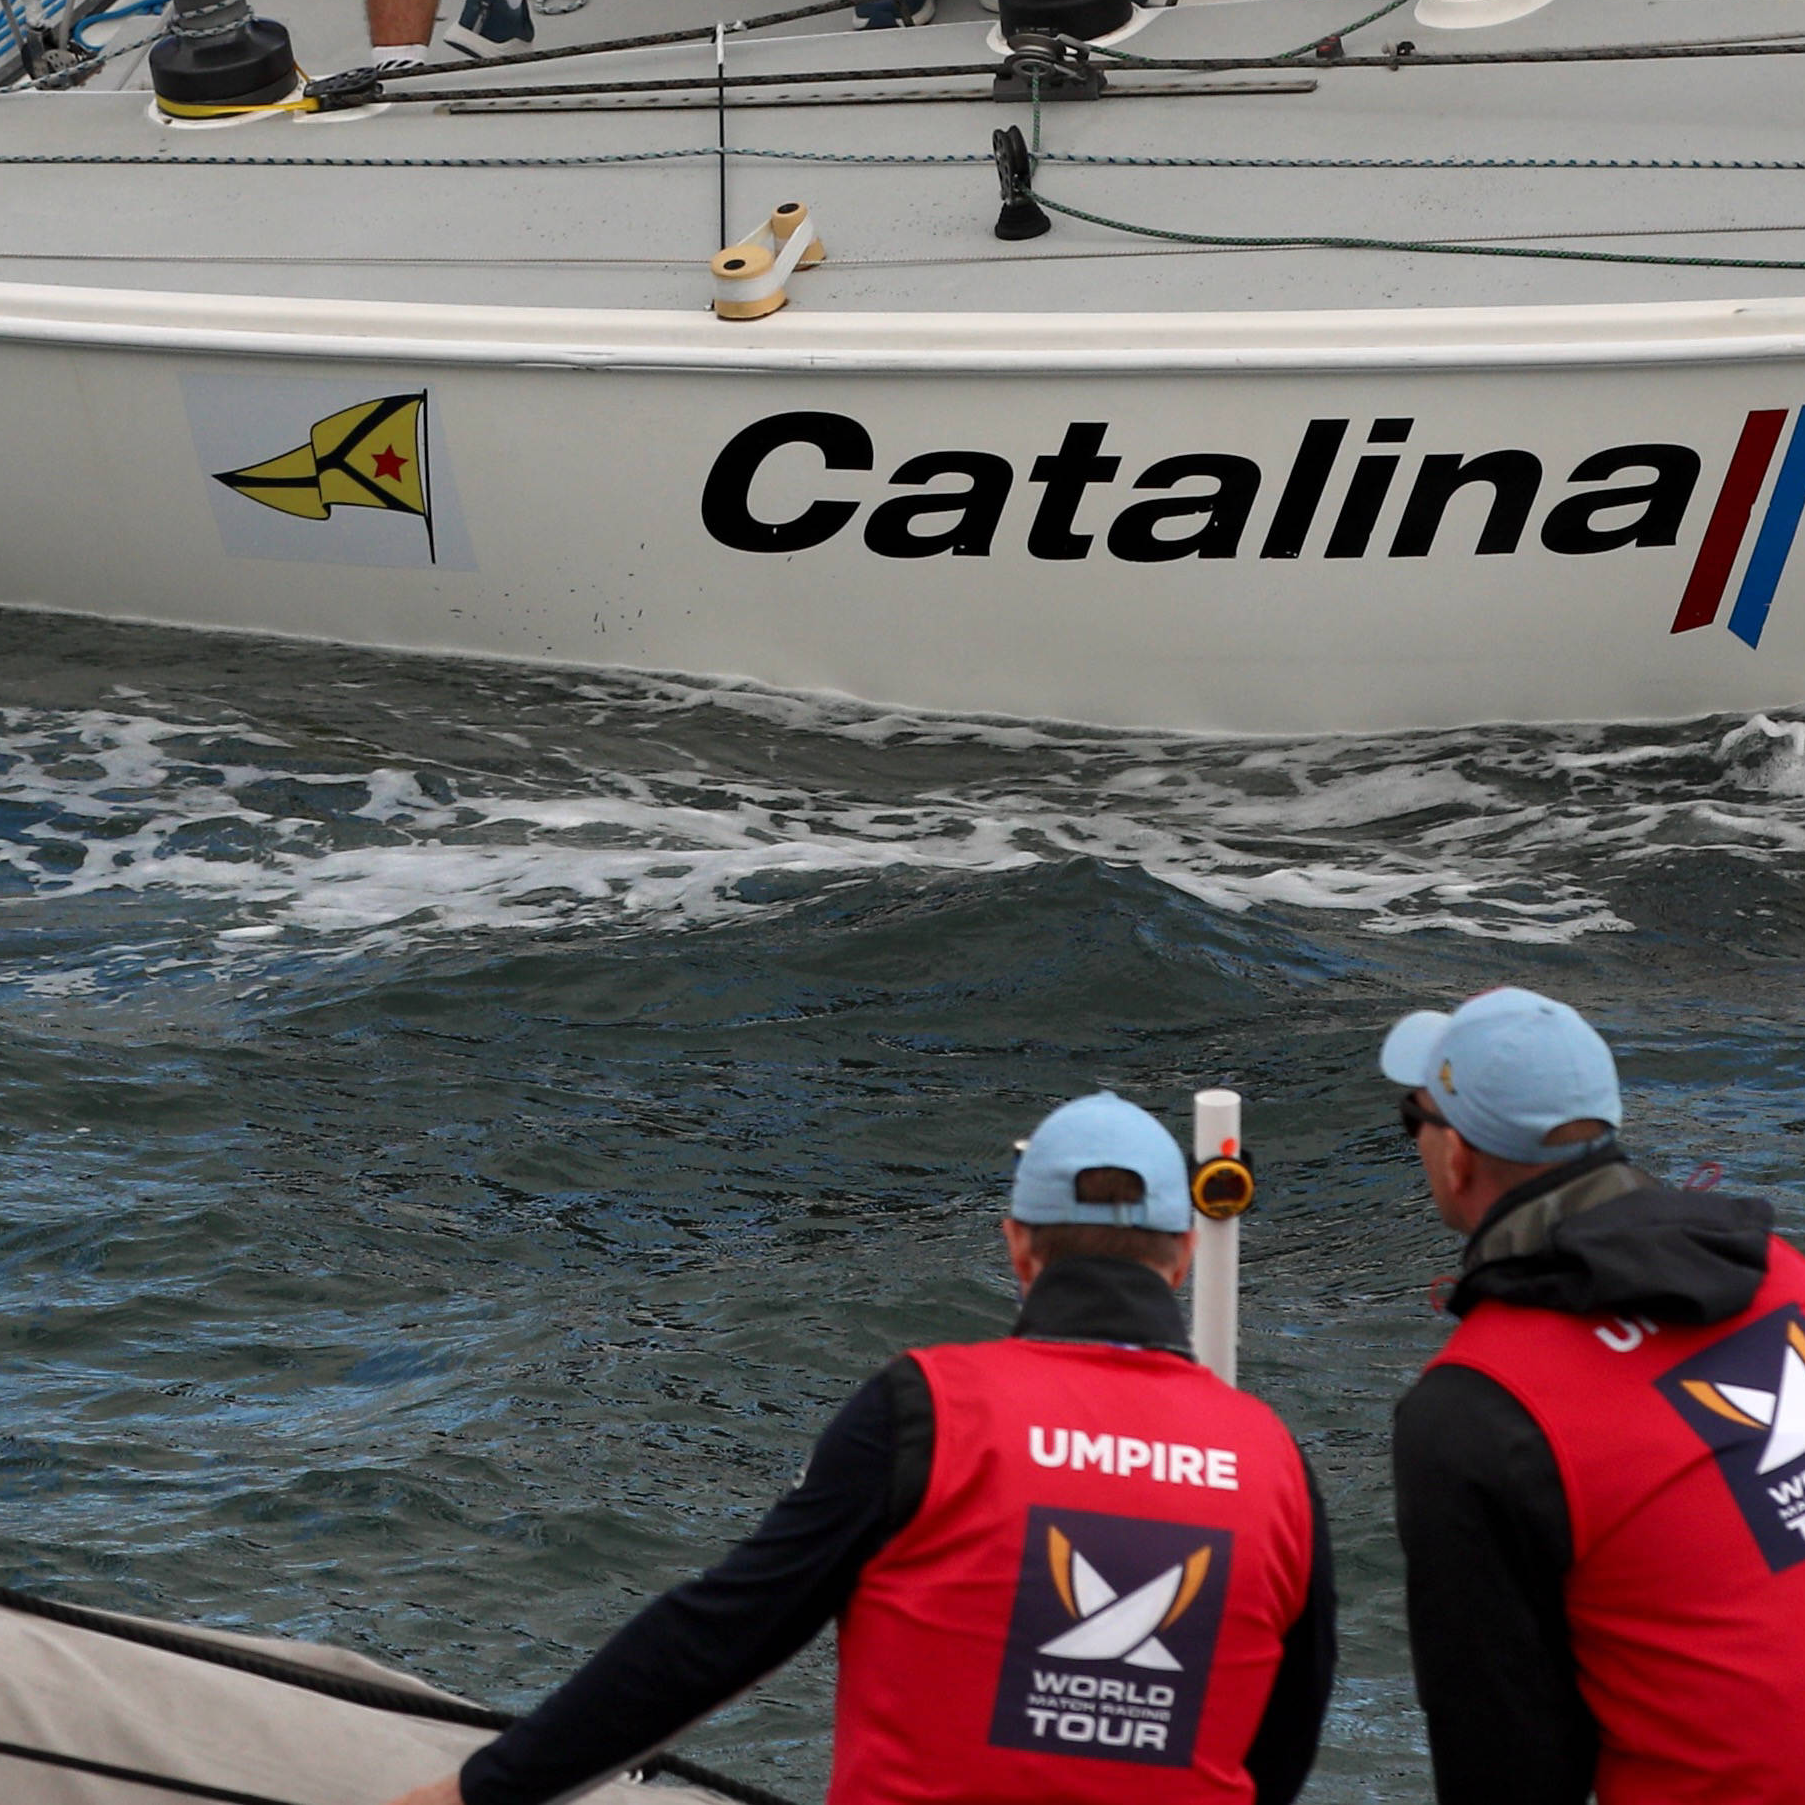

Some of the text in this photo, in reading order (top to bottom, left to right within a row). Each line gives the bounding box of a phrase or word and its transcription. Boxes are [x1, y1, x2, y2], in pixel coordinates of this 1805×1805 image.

[698, 410, 1700, 561] Catalina
[1028, 1425, 1239, 1491] UMPIRE
[1032, 1669, 1176, 1708] WORLD
[1025, 1706, 1169, 1752] TOUR
